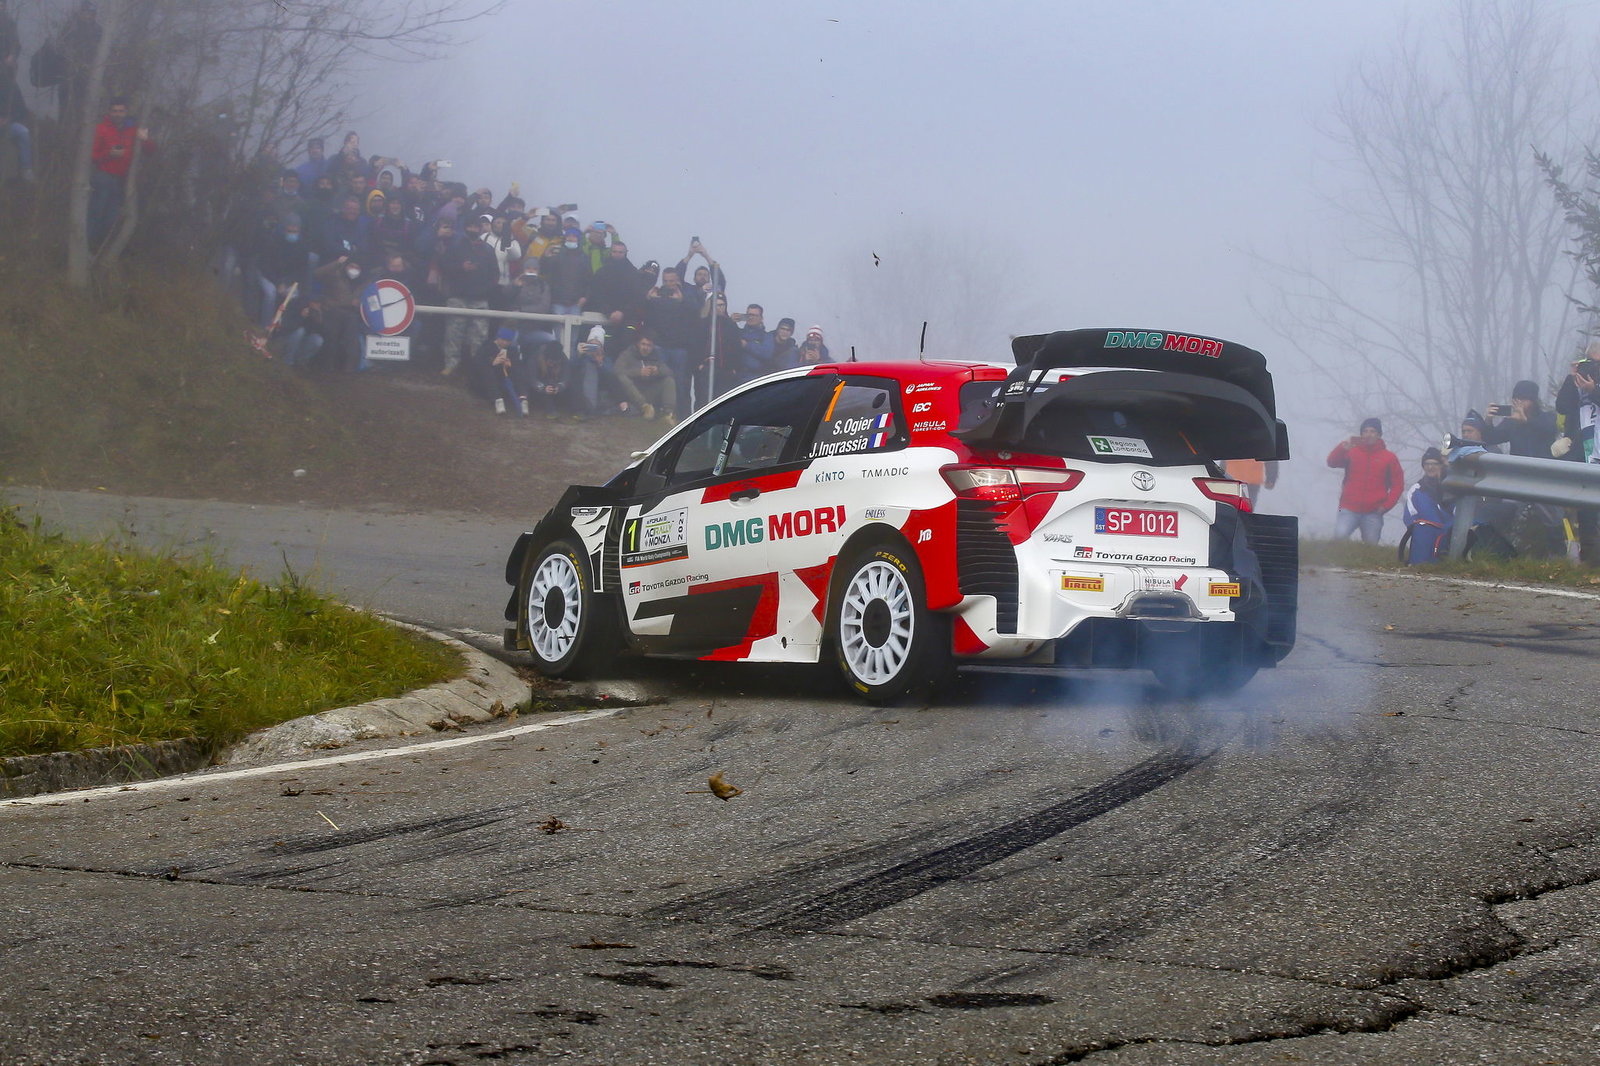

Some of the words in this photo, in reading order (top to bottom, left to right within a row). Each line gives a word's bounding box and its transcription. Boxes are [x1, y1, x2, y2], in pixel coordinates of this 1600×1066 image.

[1104, 332, 1163, 349] DMG
[1163, 334, 1223, 358] MORI
[824, 380, 846, 422] 1
[832, 416, 874, 436] S.Ogier
[913, 420, 947, 429] NISULA
[809, 436, 869, 458] J.Ingrassia
[1109, 440, 1137, 448] Regione
[1112, 446, 1148, 454] Lombardia
[862, 467, 909, 479] TAMADIC
[864, 509, 886, 519] ENDLESS
[677, 512, 685, 541] 2021
[705, 517, 763, 550] DMG
[768, 505, 846, 541] MORI
[1108, 511, 1133, 531] SP
[1139, 513, 1175, 534] 1012
[627, 520, 638, 551] 1
[648, 535, 671, 547] MONZA
[1074, 550, 1093, 558] GR
[1095, 552, 1133, 561] TOYOTA
[1135, 554, 1167, 562] GAZOO
[1169, 555, 1196, 565] Racing
[642, 582, 665, 591] TOYOTA
[665, 577, 686, 587] GAZOO
[686, 574, 709, 582] Racing
[1064, 577, 1102, 590] PIRELLI
[1210, 584, 1238, 595] PIRELLI
